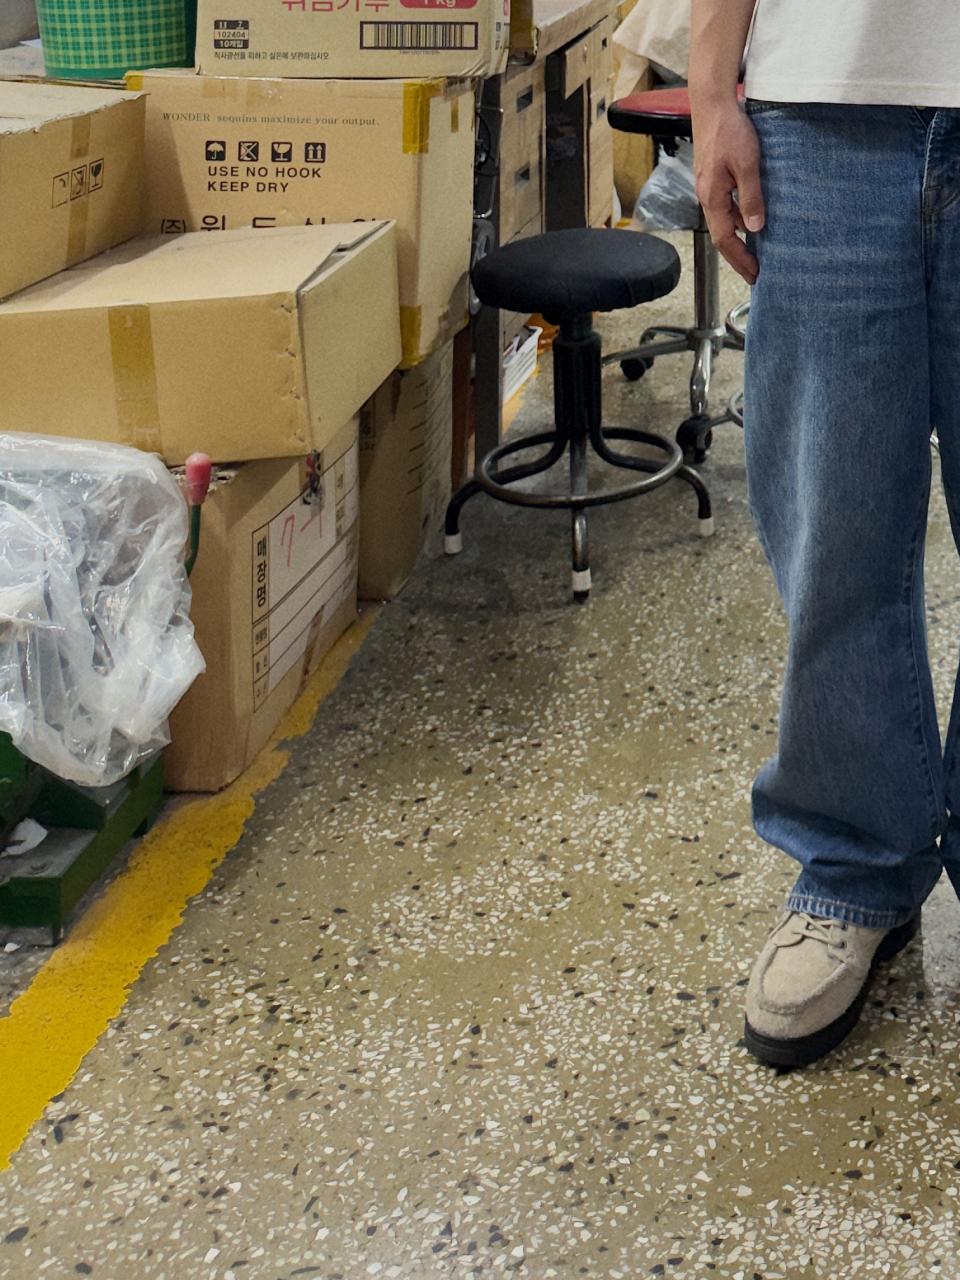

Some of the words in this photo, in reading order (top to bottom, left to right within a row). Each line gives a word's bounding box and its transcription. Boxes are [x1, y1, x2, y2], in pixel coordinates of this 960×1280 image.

[208, 166, 239, 177] USE
[246, 166, 268, 177] NO
[275, 167, 322, 178] HOOK
[207, 181, 249, 192] KEEP
[256, 182, 289, 193] DRY
